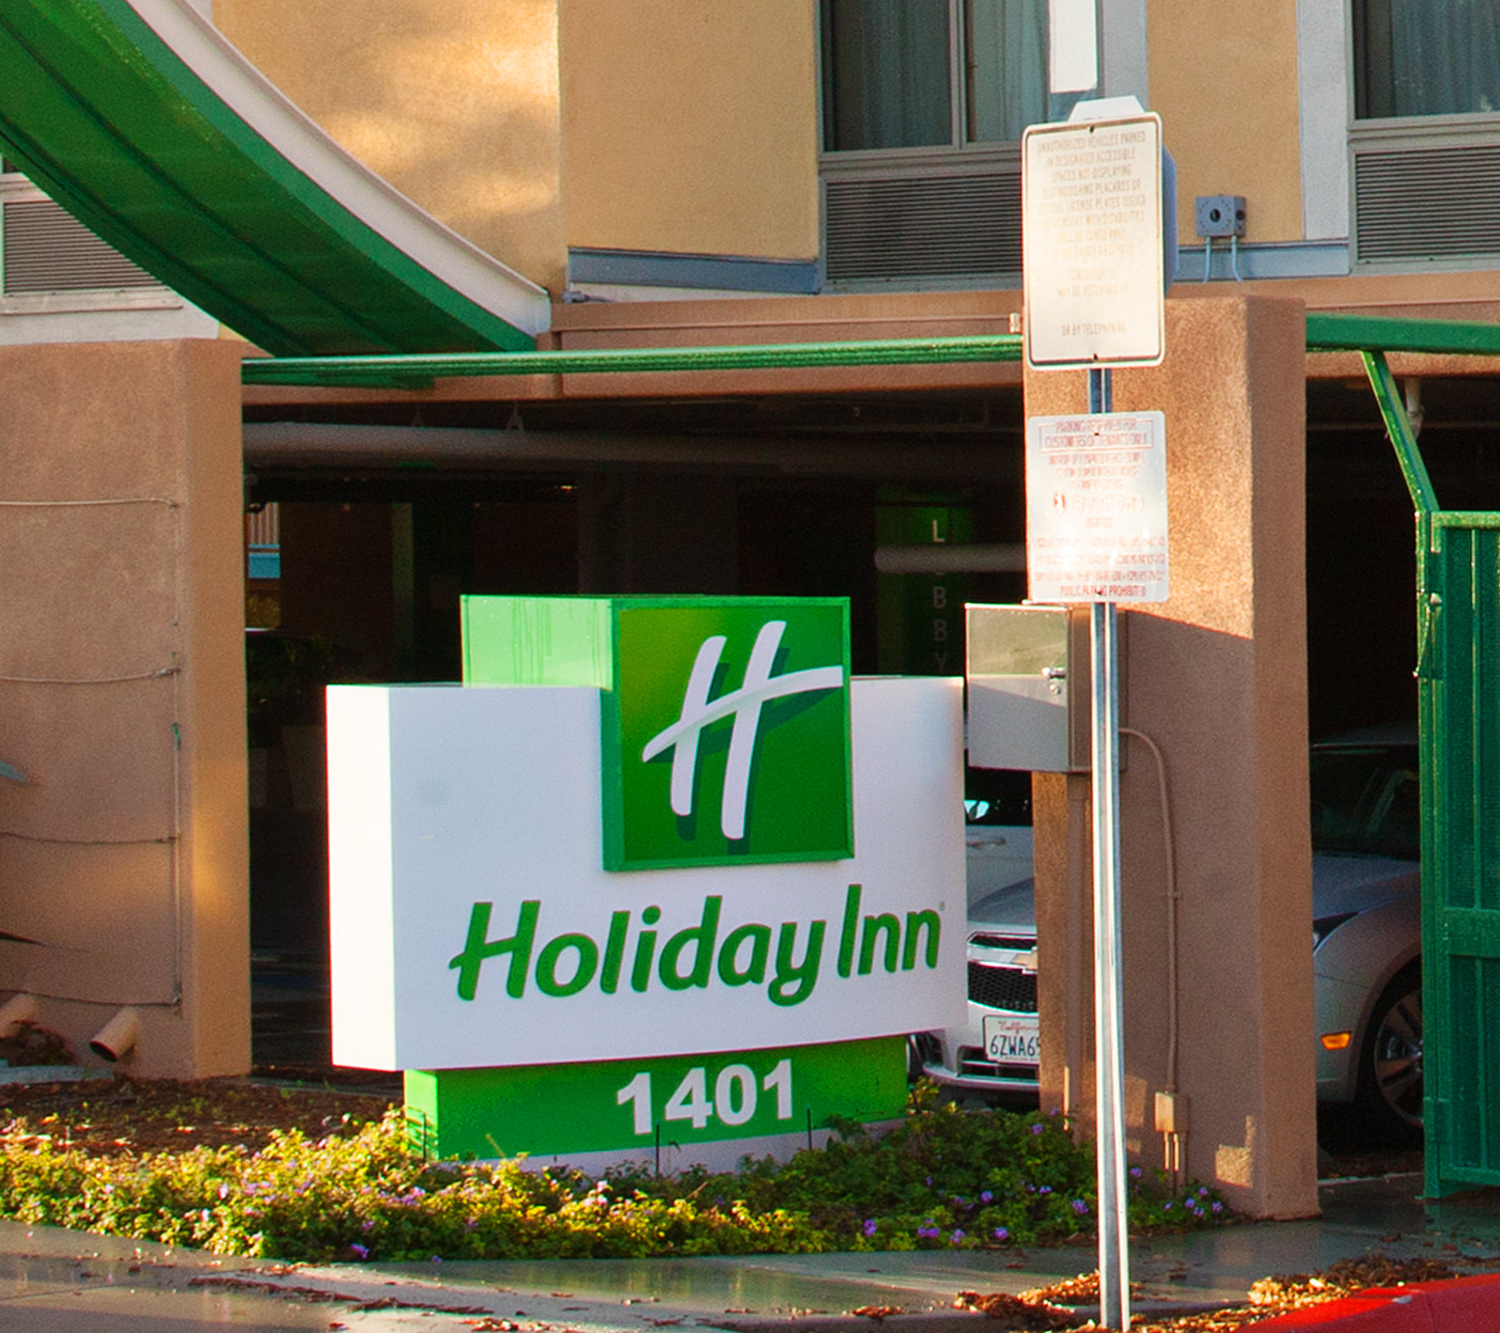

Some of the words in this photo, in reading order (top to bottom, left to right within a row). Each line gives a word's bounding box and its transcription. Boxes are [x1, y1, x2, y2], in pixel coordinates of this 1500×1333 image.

[1120, 130, 1146, 143] PARKED
[1092, 164, 1132, 180] DISPLAYING
[932, 519, 948, 674] LBBY
[449, 895, 827, 1007] Holiday
[837, 884, 942, 979] Inn
[990, 1034, 1040, 1056] 6ZWA6
[616, 1058, 793, 1135] 1401
